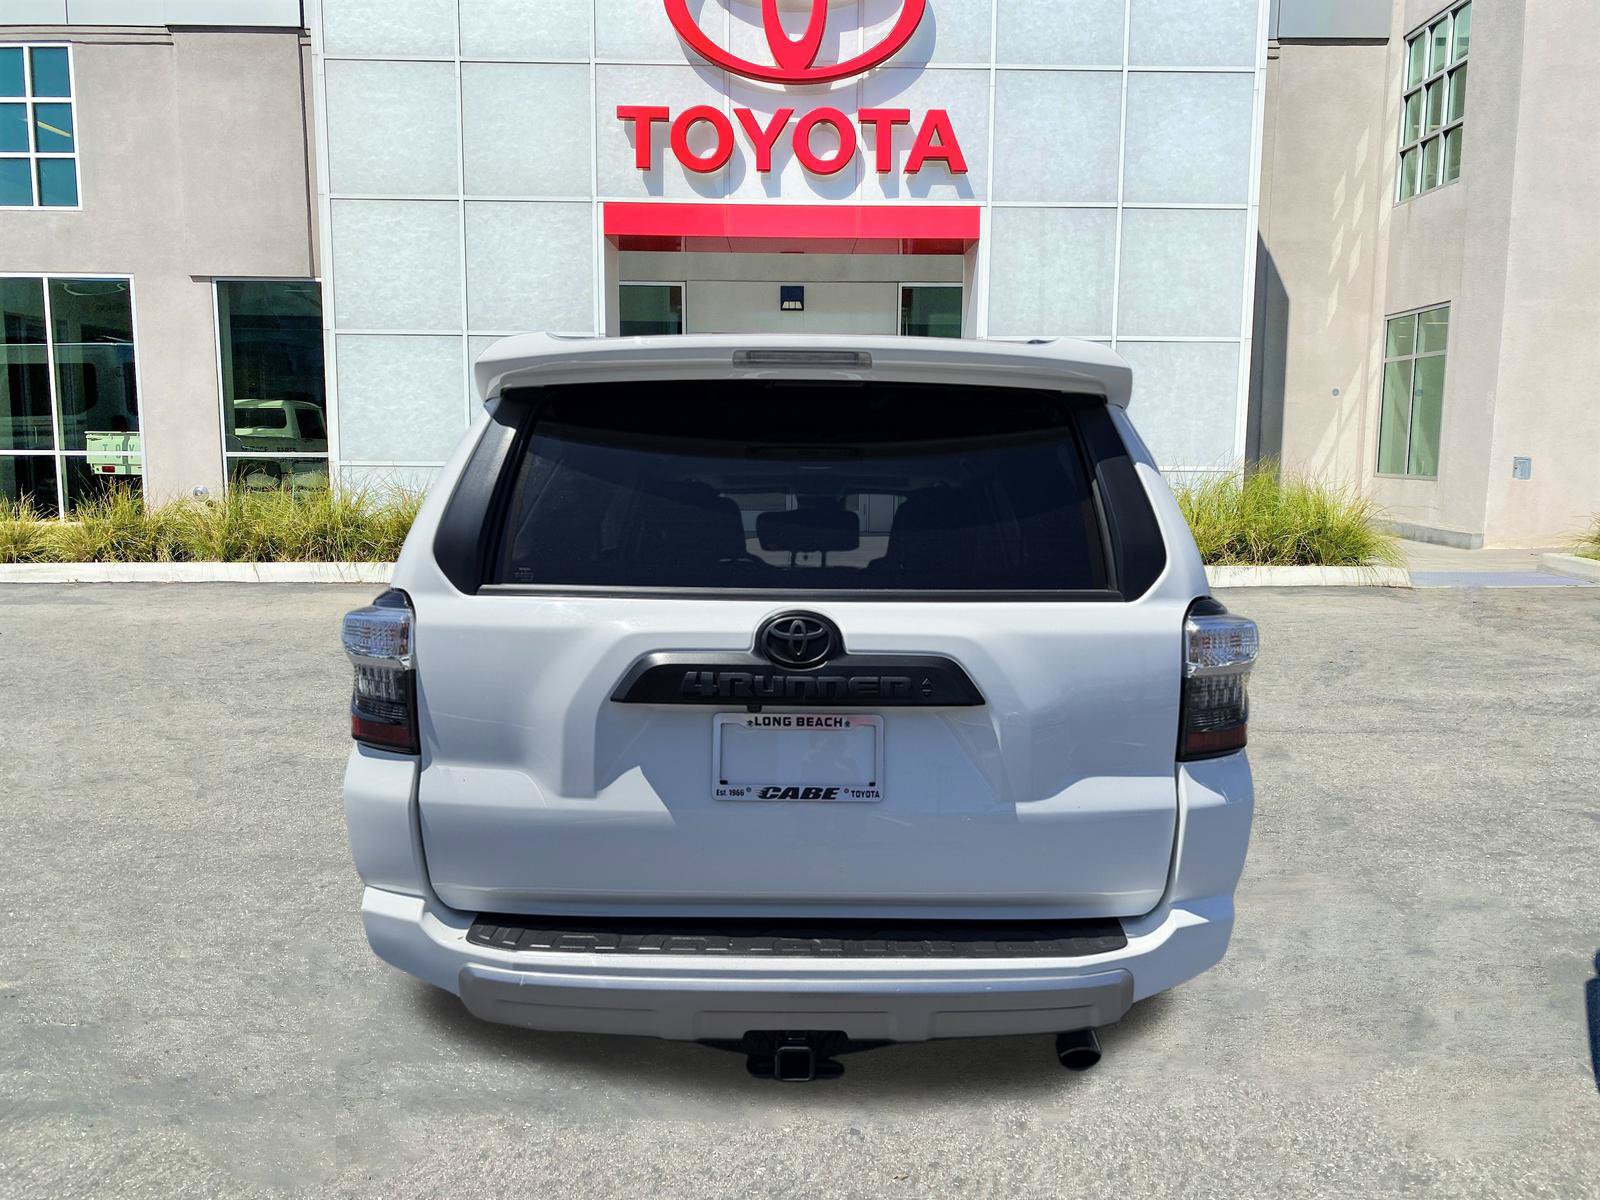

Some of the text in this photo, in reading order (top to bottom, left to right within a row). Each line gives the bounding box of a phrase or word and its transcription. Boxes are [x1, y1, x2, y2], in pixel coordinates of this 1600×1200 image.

[616, 104, 968, 175] TOYOTA
[754, 716, 843, 728] LONG BEACH
[757, 786, 840, 800] CABE
[851, 790, 880, 799] TOYOTA
